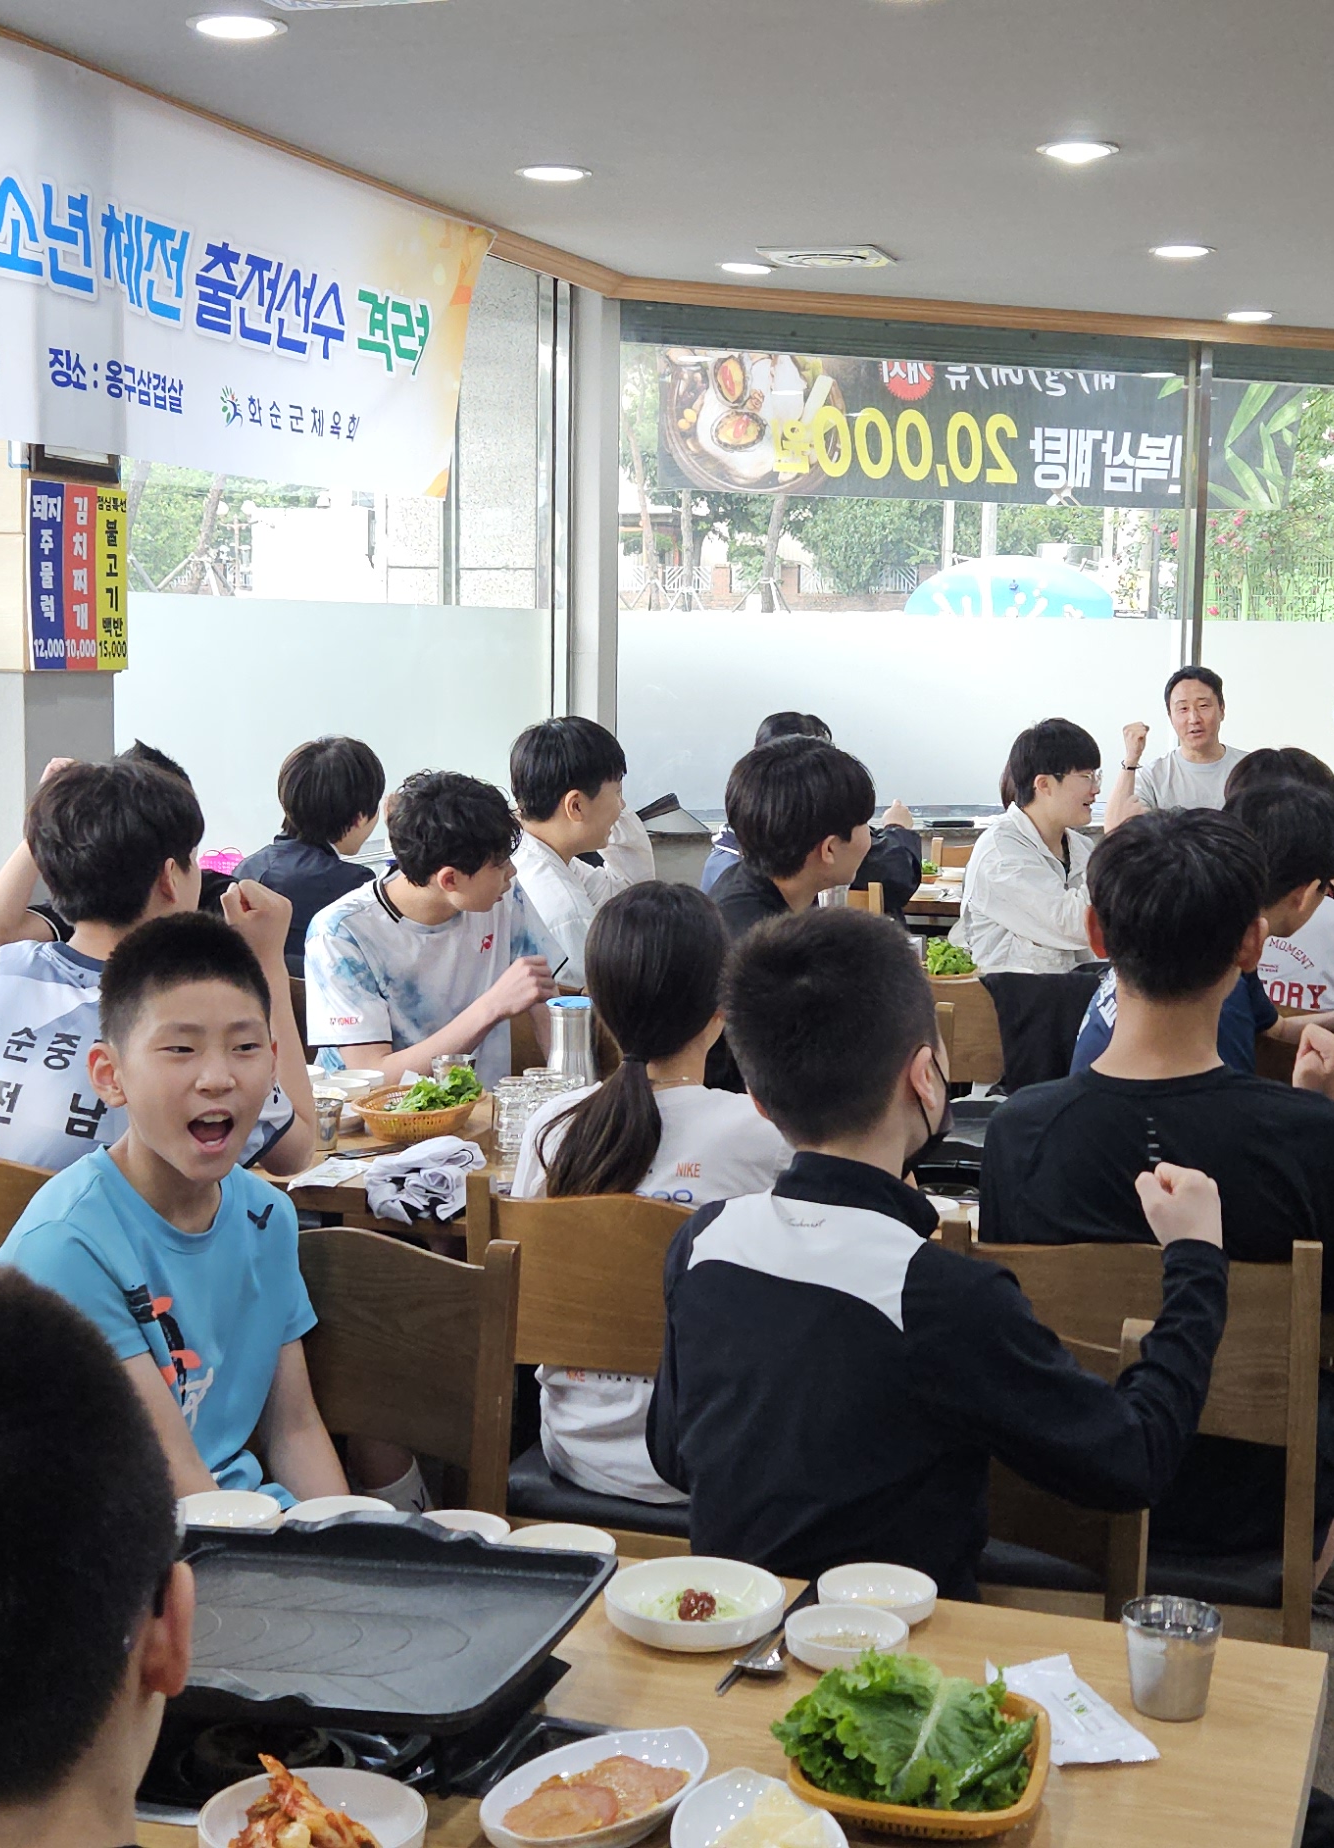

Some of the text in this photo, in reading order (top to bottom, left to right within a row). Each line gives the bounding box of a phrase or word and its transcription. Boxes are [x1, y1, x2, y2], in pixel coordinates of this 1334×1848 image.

[195, 241, 346, 361] 출전선수
[356, 287, 429, 377] 격려
[105, 359, 184, 415] 옹구삼겹살
[32, 494, 62, 622] 돼지 주물럭
[72, 496, 89, 630] 김치찌개
[33, 638, 64, 659] 12,000
[66, 638, 96, 659] 10,000
[98, 640, 127, 660] 15,000
[1269, 937, 1315, 970] MOMENT
[1260, 979, 1328, 1010] ORY
[675, 1162, 701, 1178] NIKE
